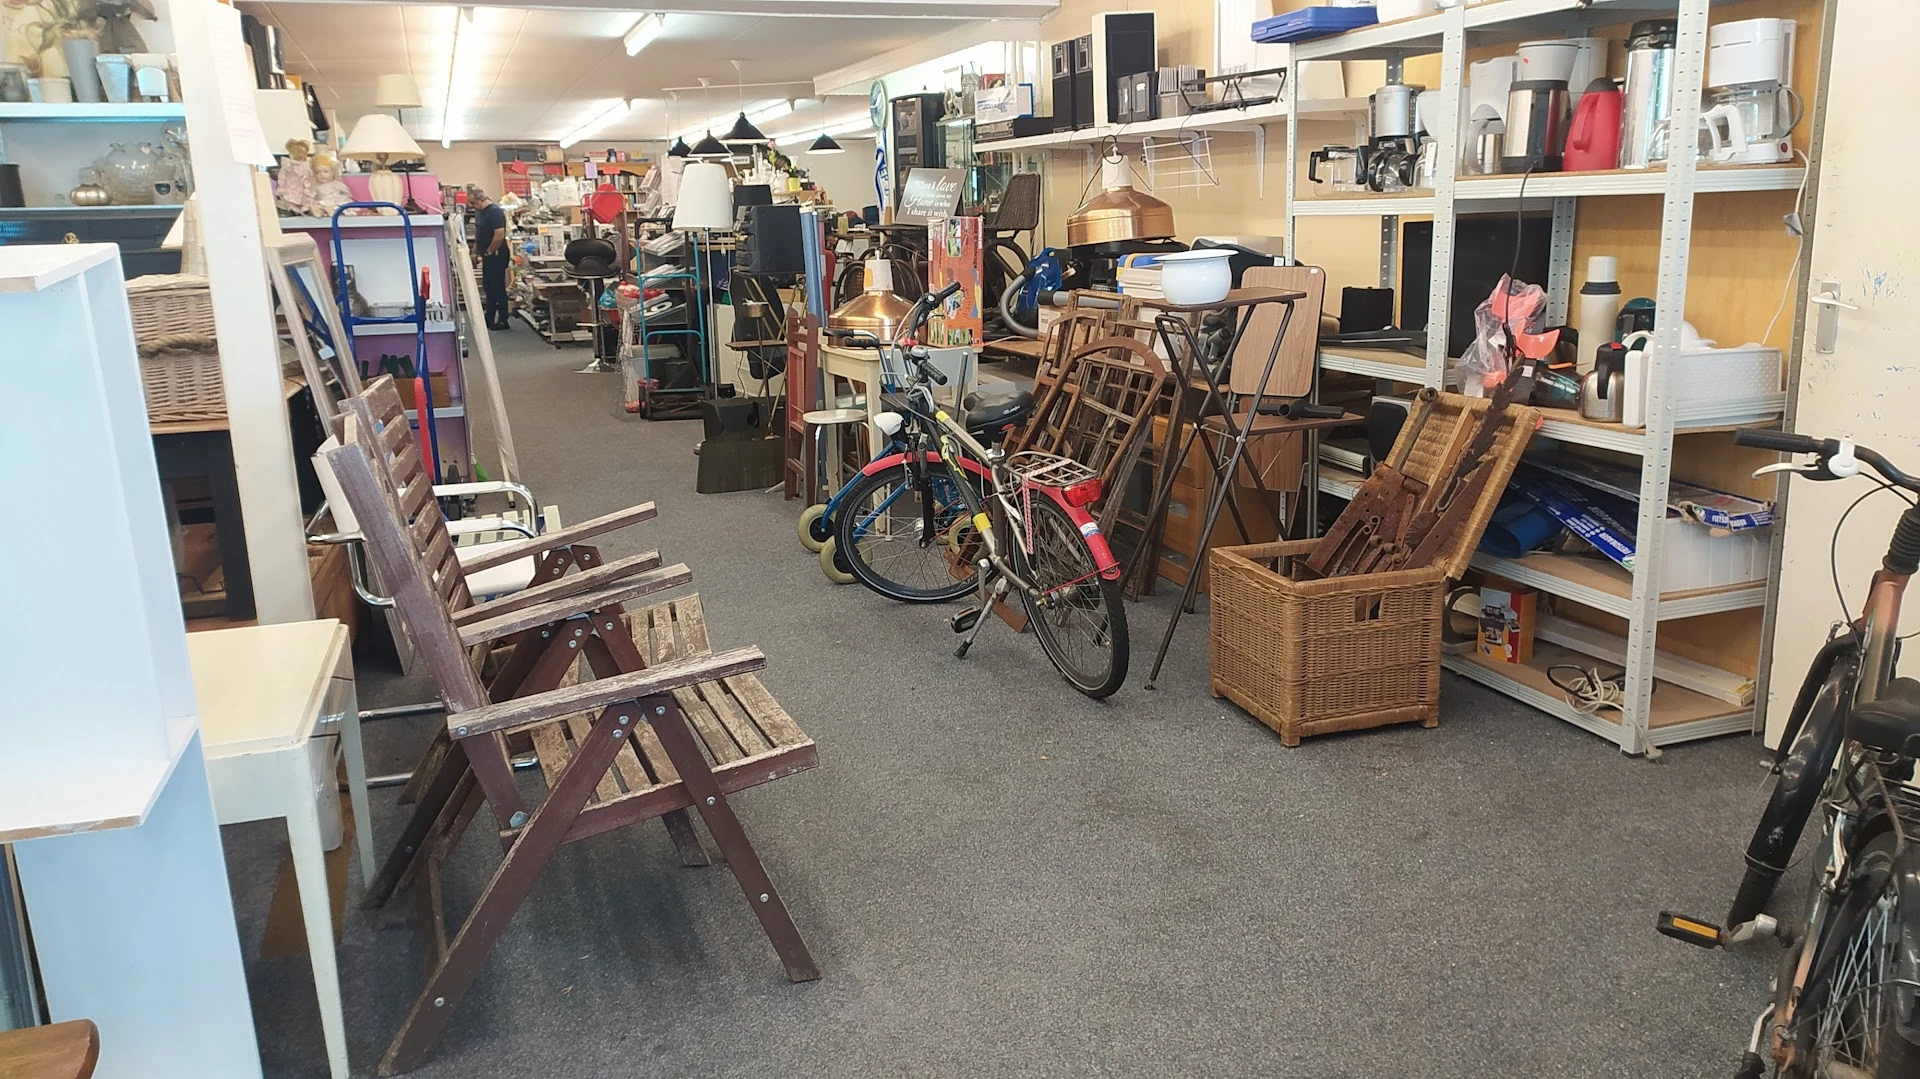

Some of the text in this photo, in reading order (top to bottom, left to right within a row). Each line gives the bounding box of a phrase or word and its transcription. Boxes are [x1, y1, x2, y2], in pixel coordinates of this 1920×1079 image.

[915, 180, 932, 189] What
[936, 175, 958, 192] love
[903, 193, 934, 208] Home
[906, 207, 912, 215] I
[911, 207, 927, 216] share
[927, 209, 933, 217] it
